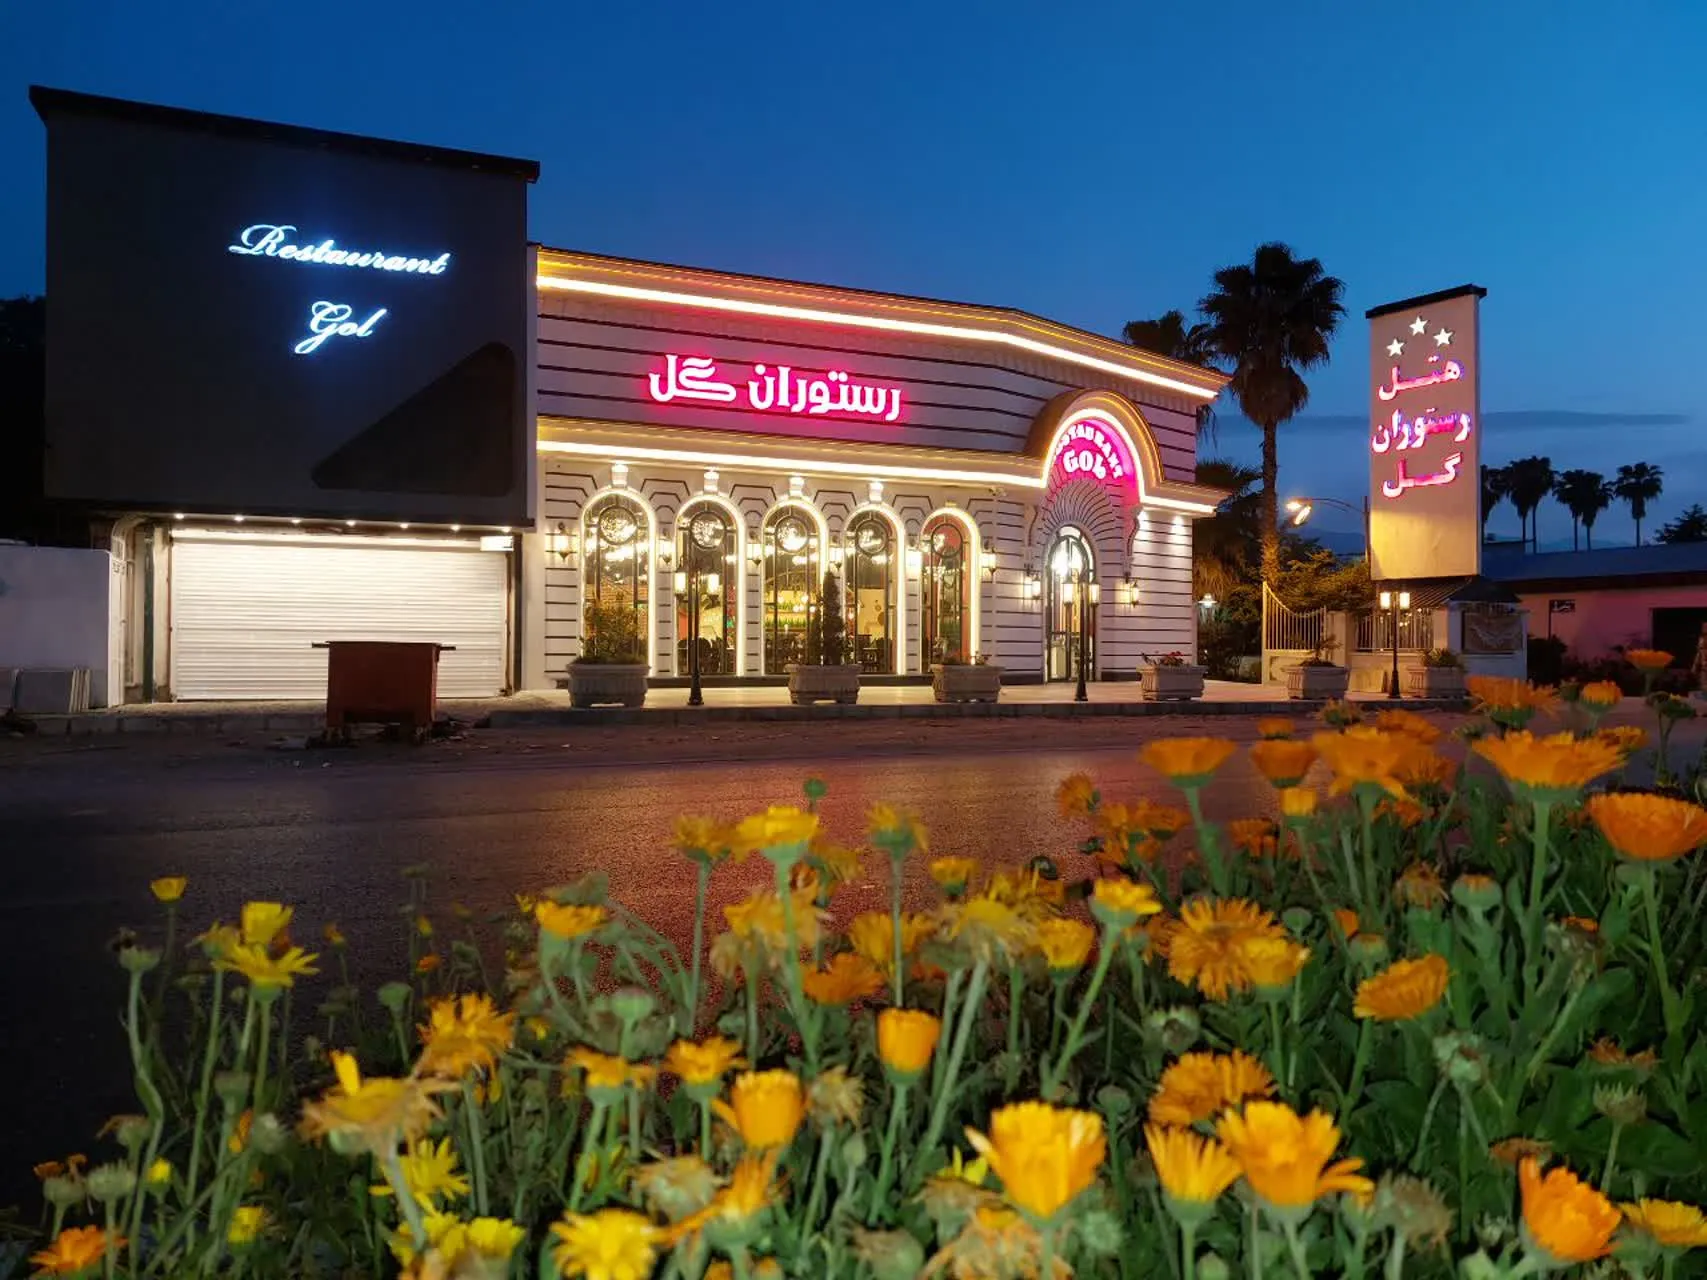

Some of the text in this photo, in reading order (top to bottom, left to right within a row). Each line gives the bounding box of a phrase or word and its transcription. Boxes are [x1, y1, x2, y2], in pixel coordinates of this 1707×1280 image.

[228, 224, 450, 275] Restaurant
[294, 300, 387, 354] Gol
[649, 354, 901, 421] رستوران گل
[1371, 407, 1469, 452] رستوران
[1062, 449, 1107, 480] GOL
[1382, 452, 1461, 498] گل
